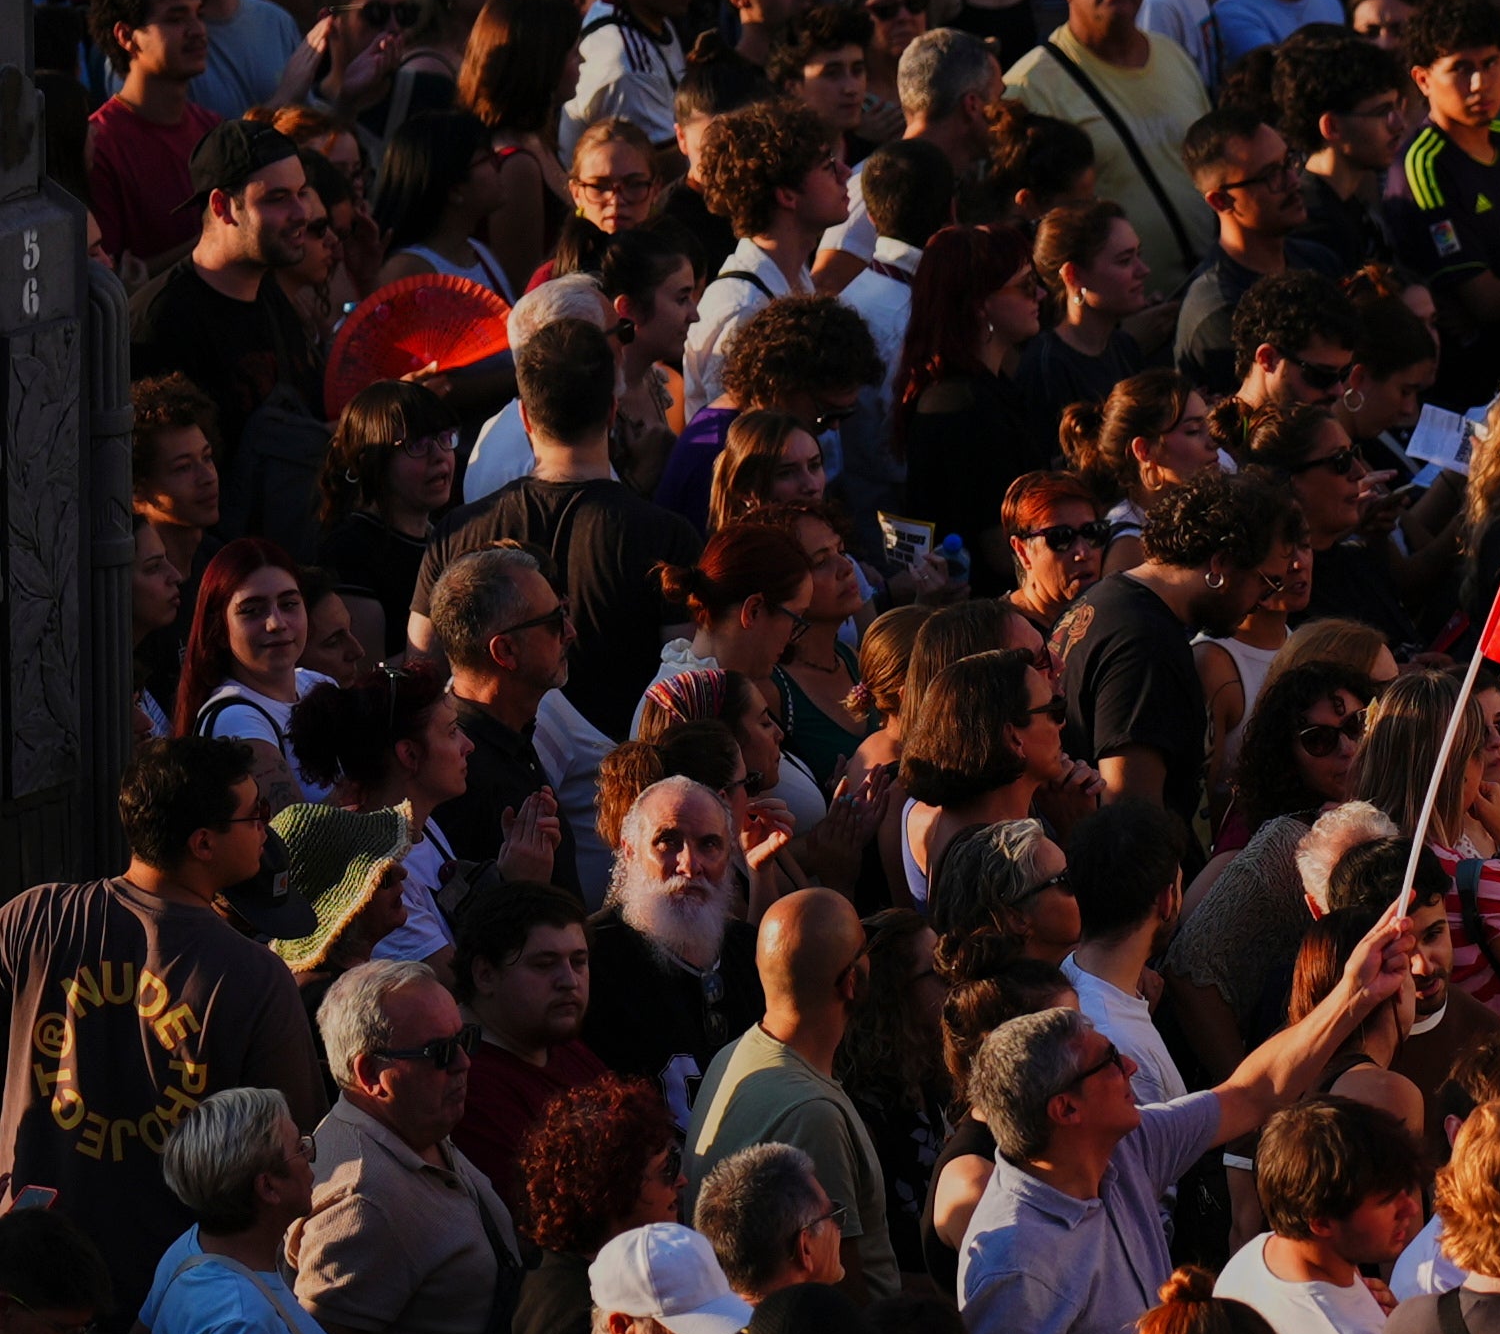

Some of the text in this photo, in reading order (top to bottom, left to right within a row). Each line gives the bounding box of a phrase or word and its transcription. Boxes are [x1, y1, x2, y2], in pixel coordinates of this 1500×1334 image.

[22, 229, 41, 271] 5
[22, 277, 40, 315] 6
[60, 960, 202, 1052] NUDE
